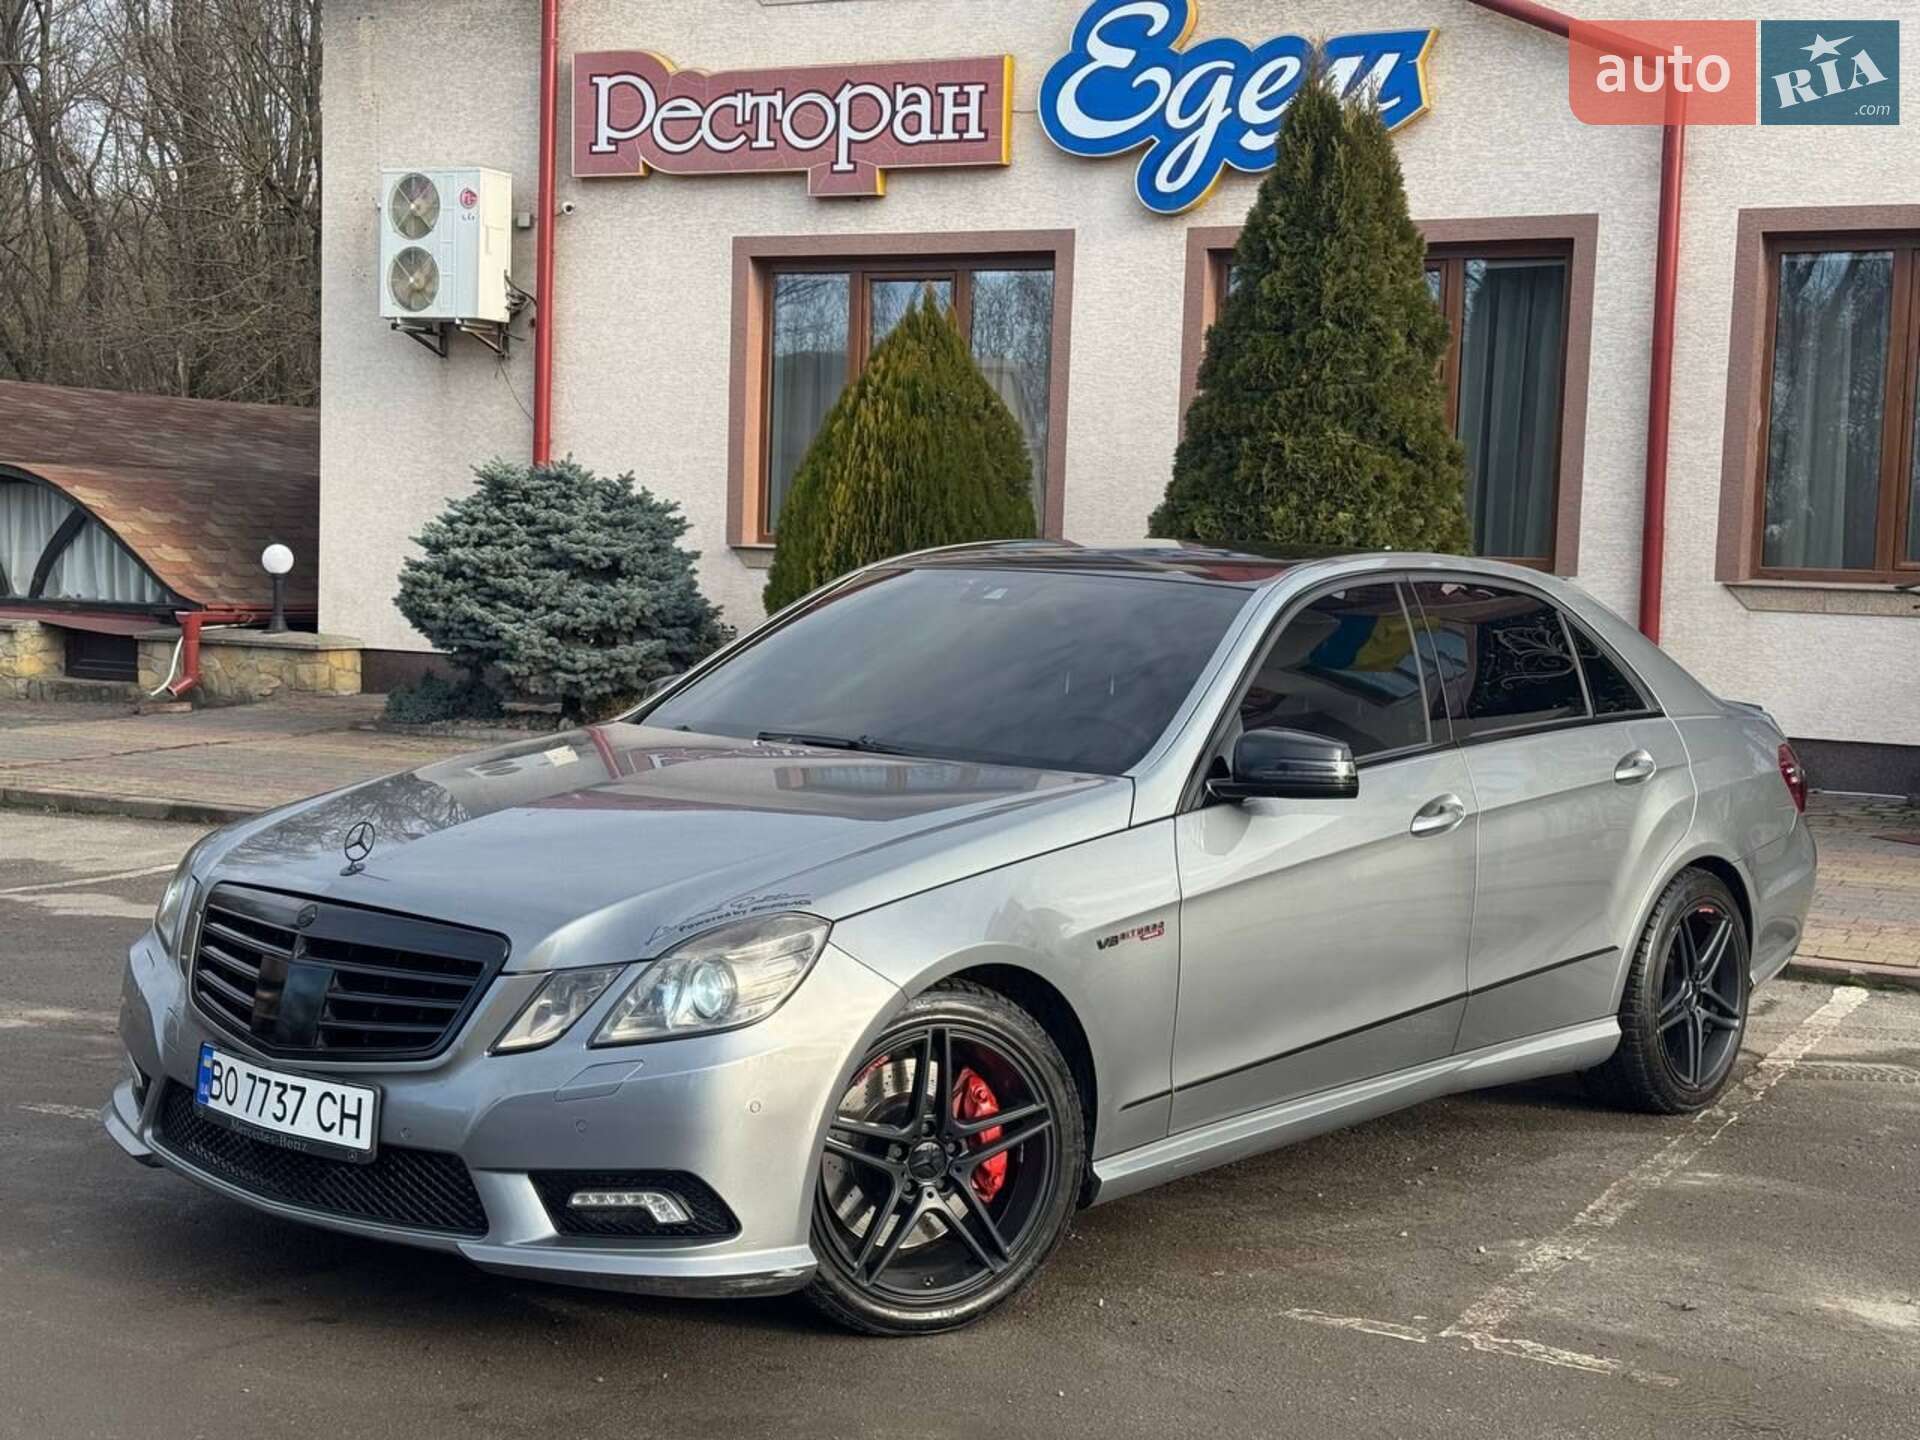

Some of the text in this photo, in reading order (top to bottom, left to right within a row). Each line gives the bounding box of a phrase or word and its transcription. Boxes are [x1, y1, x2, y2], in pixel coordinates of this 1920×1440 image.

[590, 73, 988, 172] Ресторан
[209, 1060, 362, 1140] BO 7737 CH
